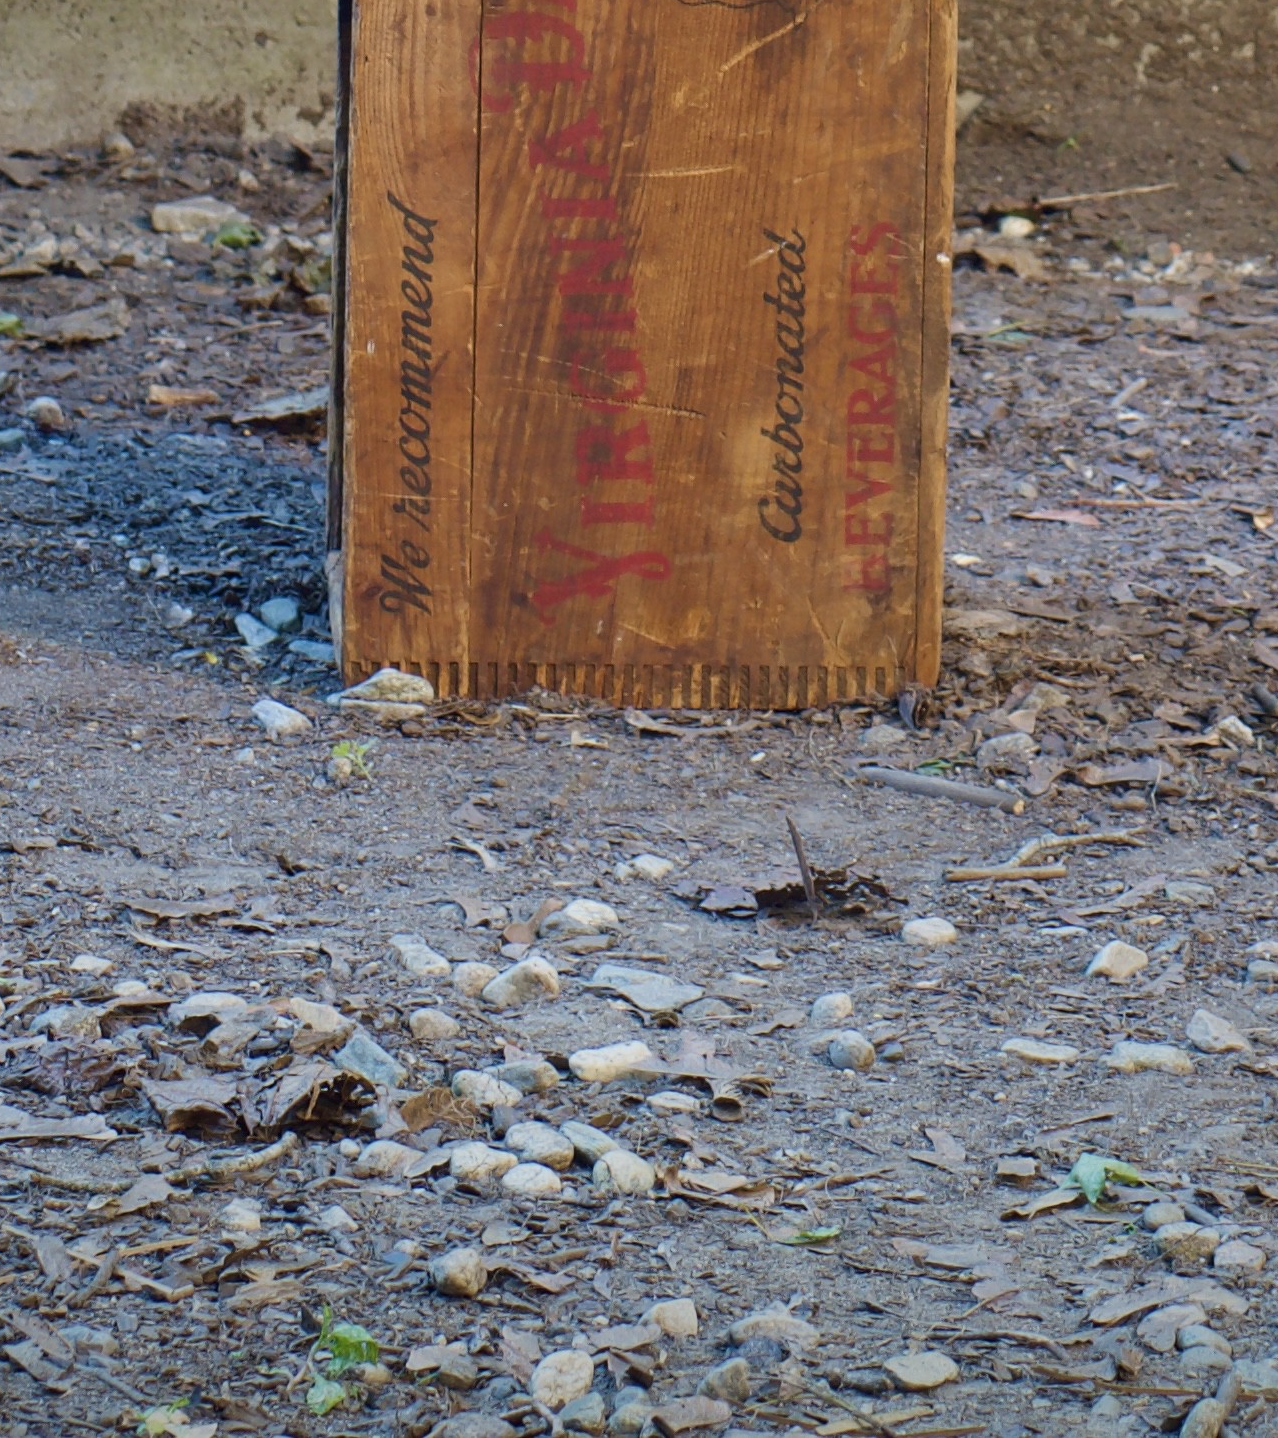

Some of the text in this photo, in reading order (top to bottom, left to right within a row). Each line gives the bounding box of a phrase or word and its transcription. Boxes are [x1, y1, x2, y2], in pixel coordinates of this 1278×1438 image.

[377, 187, 441, 620] We recommend
[518, 105, 674, 627] VIRGINIA
[758, 226, 810, 547] Carbonated
[843, 218, 904, 594] BEVERAGES
